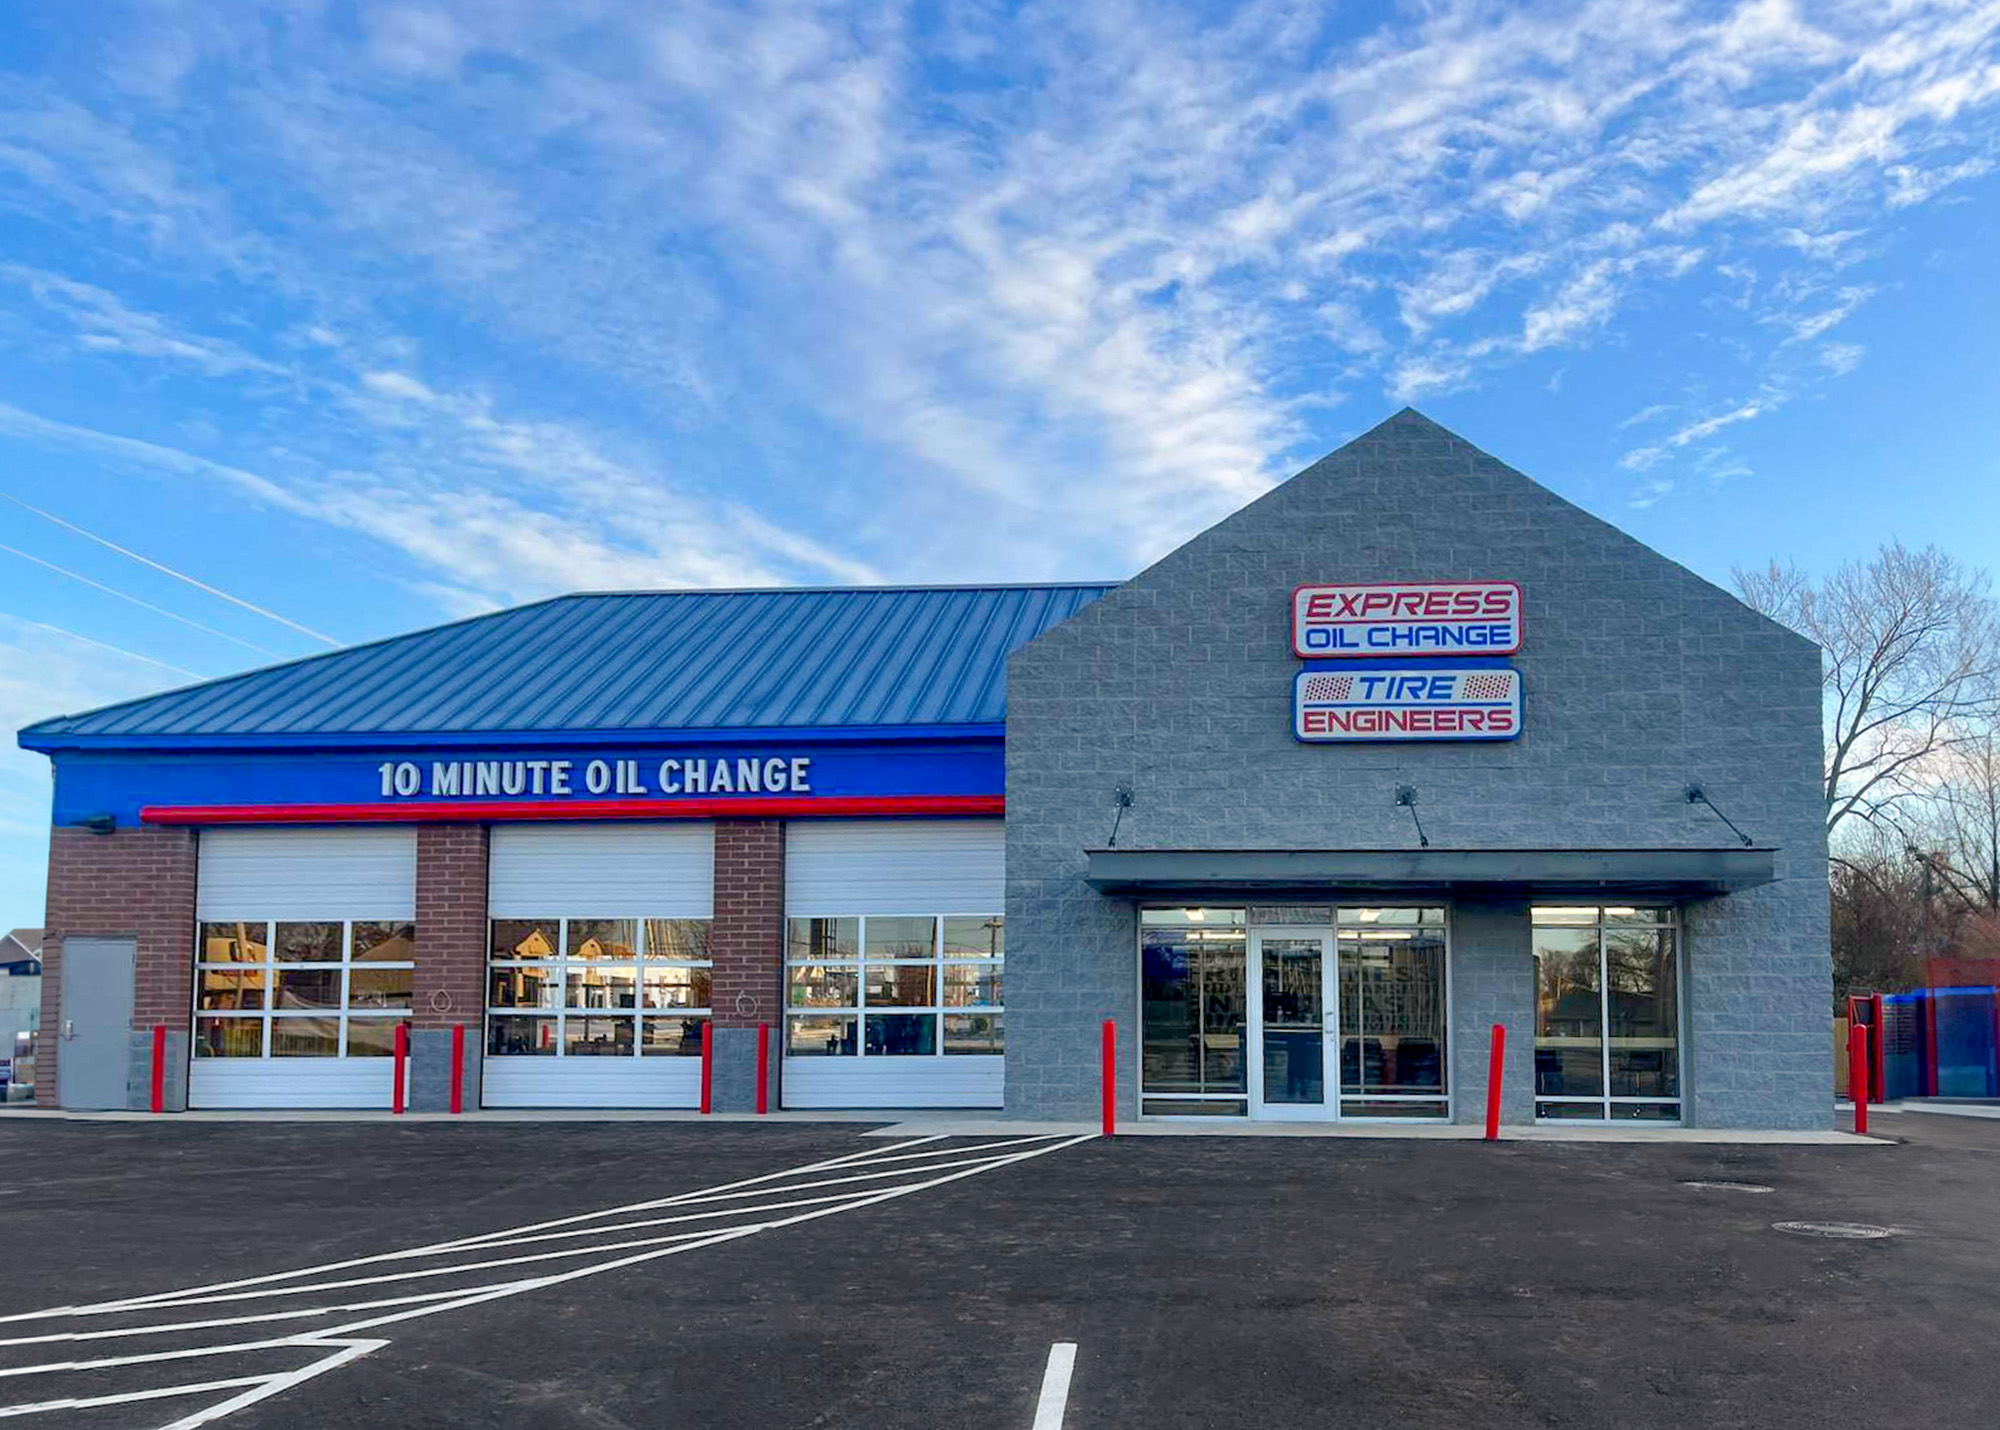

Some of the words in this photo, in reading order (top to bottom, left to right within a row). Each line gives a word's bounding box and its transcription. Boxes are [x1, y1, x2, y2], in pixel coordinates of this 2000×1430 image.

[1305, 590, 1513, 618] EXPRESS
[1305, 627, 1359, 649] OIL
[1367, 624, 1512, 647] CHANGE
[1359, 675, 1457, 700] TIRE
[1303, 709, 1513, 733] ENGINEERS
[378, 761, 421, 797] 10
[431, 760, 573, 796] MINUTE
[585, 758, 648, 795] OIL
[658, 757, 811, 794] CHANGE
